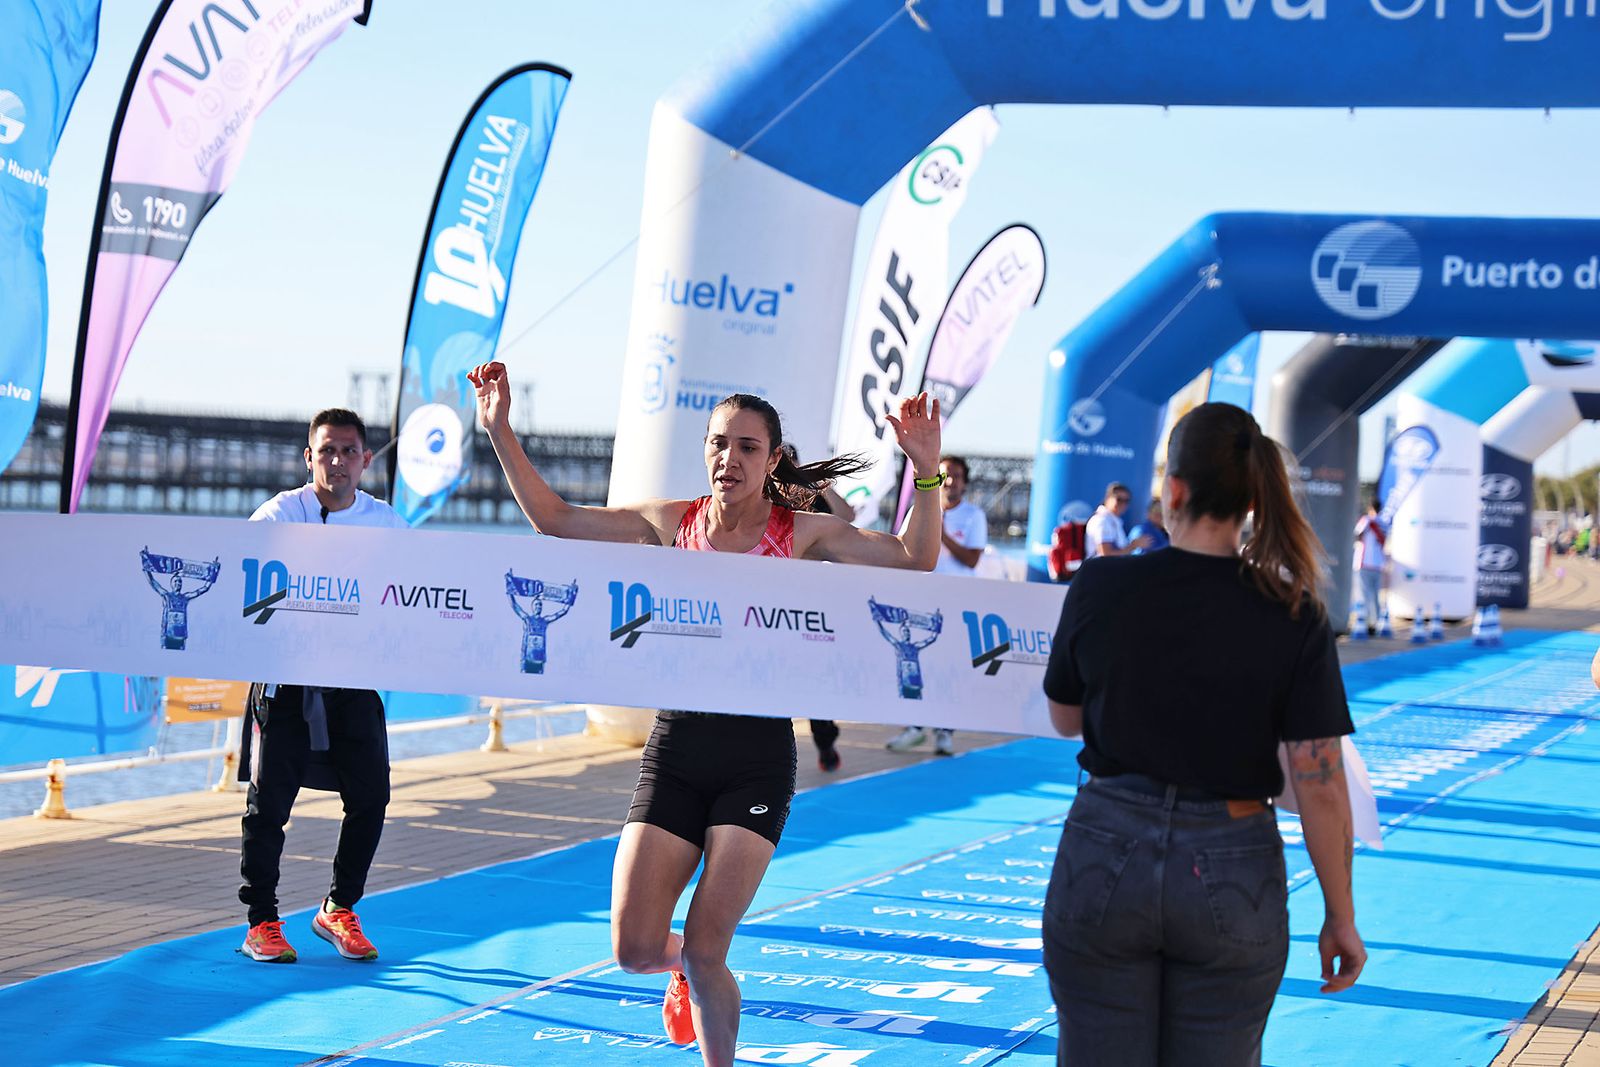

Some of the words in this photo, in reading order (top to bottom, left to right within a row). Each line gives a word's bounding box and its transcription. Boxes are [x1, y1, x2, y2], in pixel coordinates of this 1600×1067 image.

[456, 114, 517, 238] HUELVA
[143, 196, 187, 229] 1790
[1441, 254, 1564, 289] Puerto
[1573, 255, 1600, 290] d
[862, 250, 919, 440] CSIF
[675, 390, 725, 412] HUE
[242, 558, 288, 618] 10
[287, 574, 360, 603] HUELVA
[380, 584, 474, 611] AVATEL
[439, 611, 473, 620] TELECOM
[608, 581, 651, 641] 10
[650, 597, 722, 626] HUELVA
[744, 606, 835, 633] AVATEL
[801, 633, 836, 642] TELECOM
[962, 610, 1010, 668] 10
[761, 945, 934, 966] HUELVA
